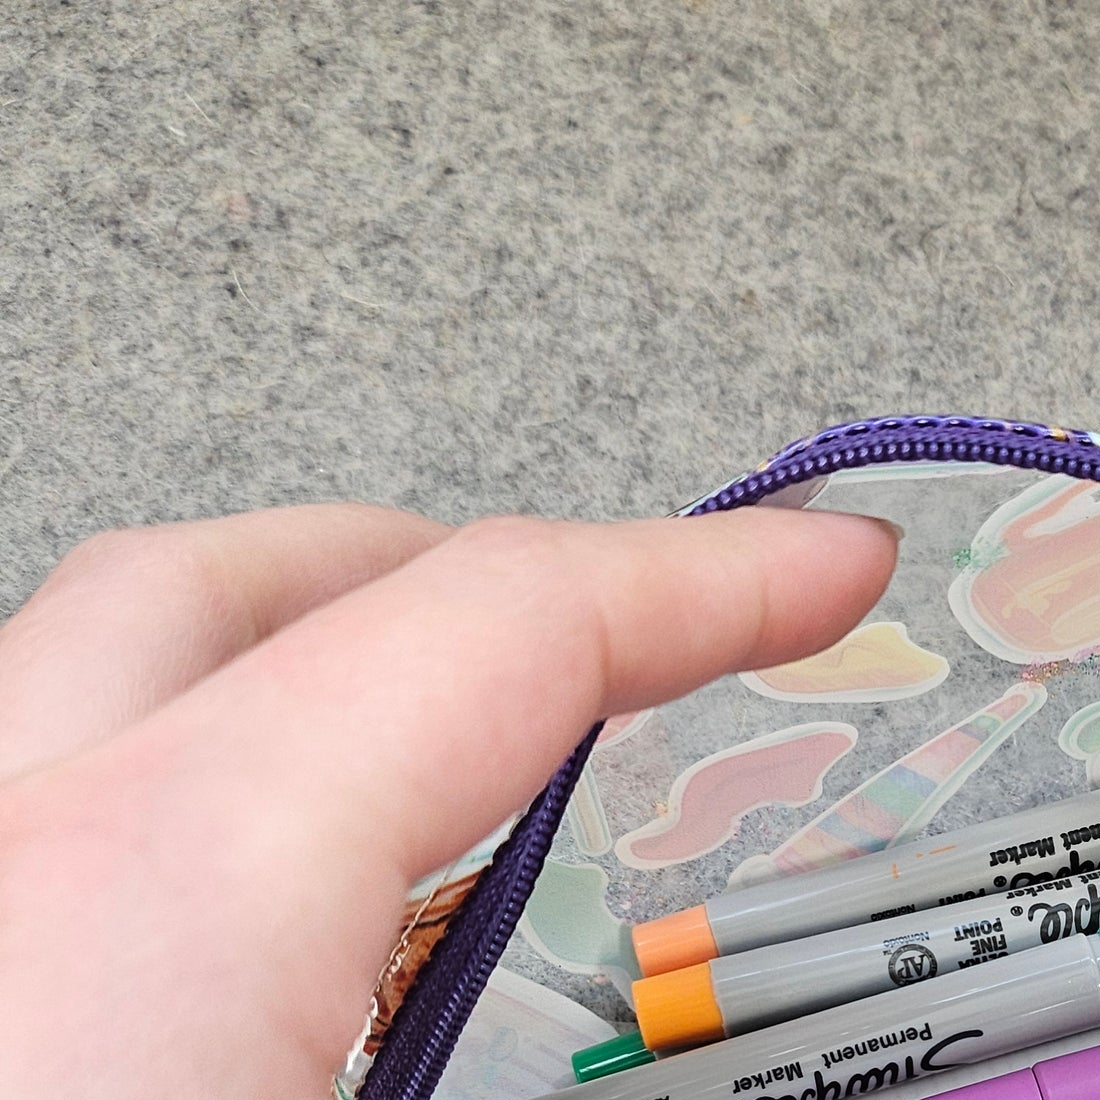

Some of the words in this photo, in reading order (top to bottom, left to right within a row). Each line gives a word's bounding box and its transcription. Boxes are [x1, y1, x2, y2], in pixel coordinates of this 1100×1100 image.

[989, 836, 1056, 867] Marker
[954, 917, 1004, 942] POINT
[969, 933, 1008, 956] FINE
[821, 1022, 933, 1070] Permanent
[732, 1061, 804, 1095] Marker
